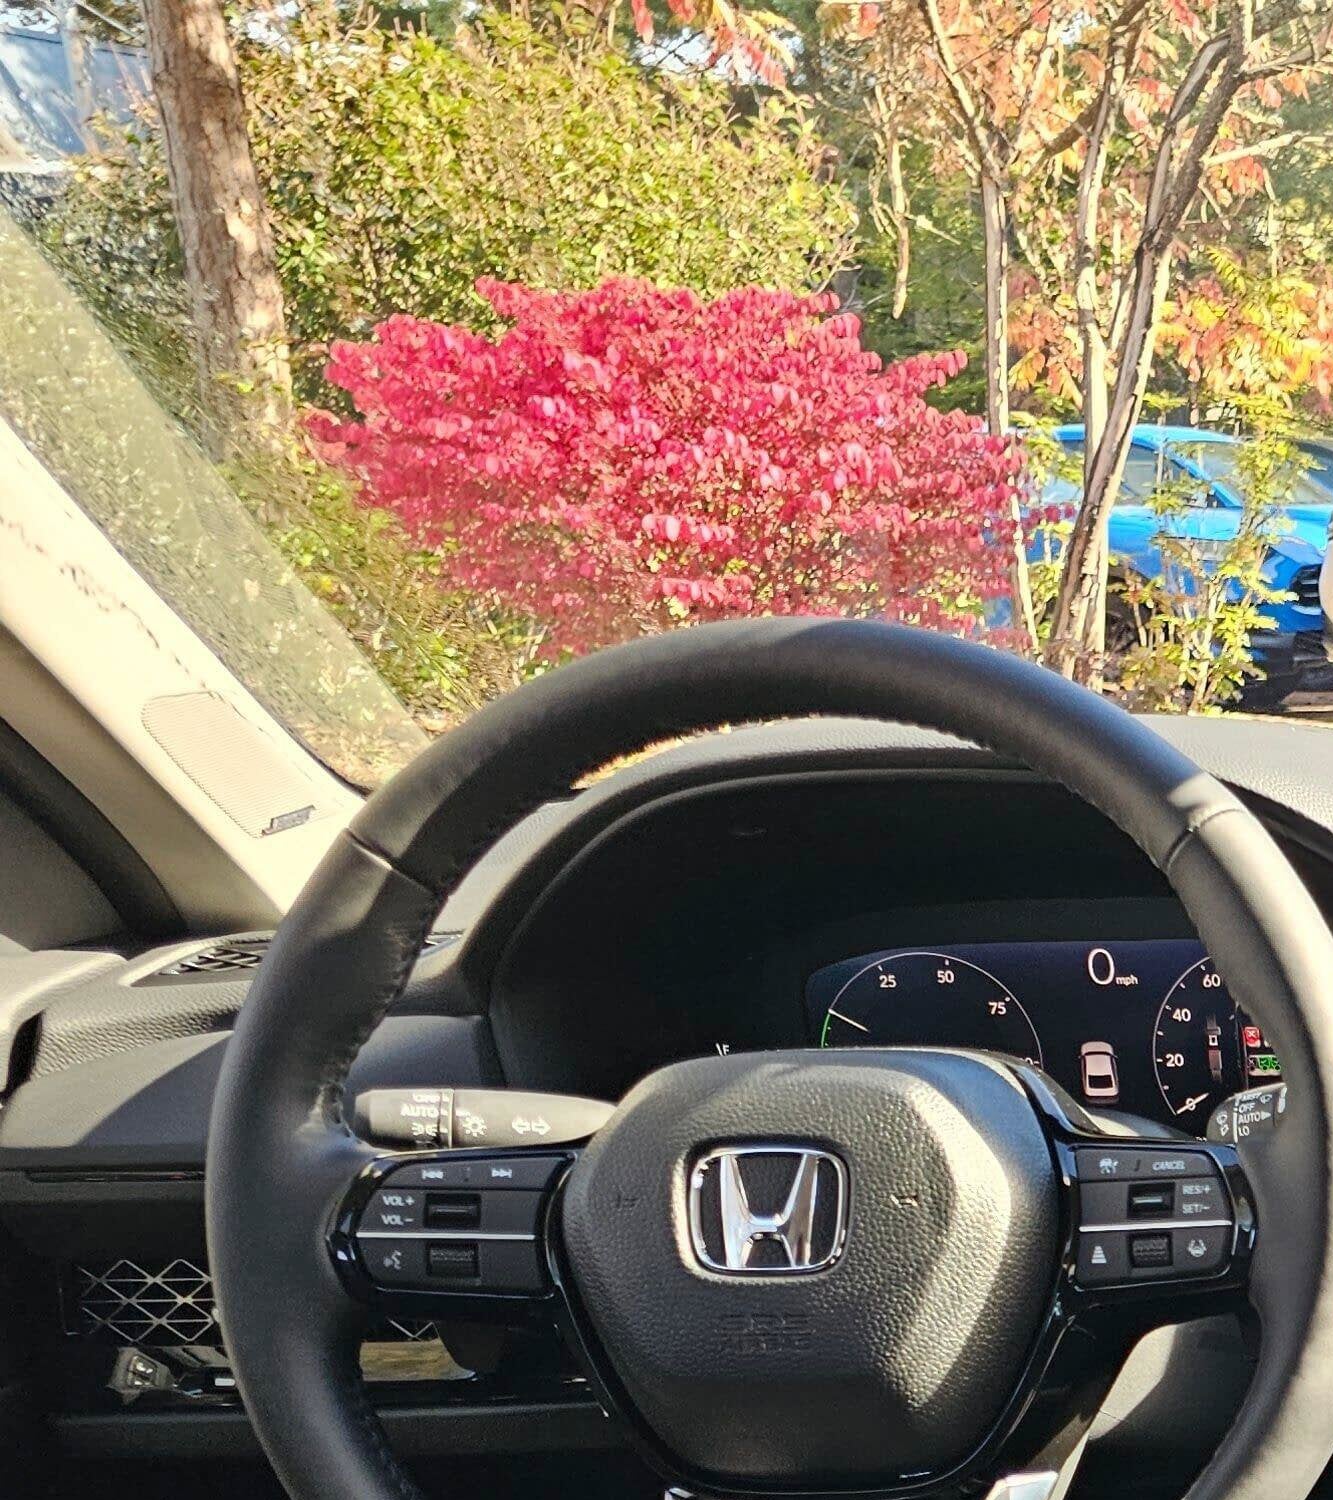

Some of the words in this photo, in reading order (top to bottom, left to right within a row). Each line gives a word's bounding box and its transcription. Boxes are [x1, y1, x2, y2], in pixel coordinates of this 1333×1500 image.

[1087, 948, 1115, 985] 0
[1115, 975, 1139, 988] mph
[879, 974, 896, 989] 25
[937, 971, 955, 984] 50
[1202, 974, 1221, 988] 60
[988, 1001, 1007, 1015] 75
[1172, 1008, 1191, 1023] 40
[1165, 1053, 1185, 1067] 20
[400, 1103, 440, 1118] AUTO
[1238, 1103, 1255, 1113] OFF
[1238, 1114, 1261, 1124] AUTO
[1238, 1126, 1250, 1136] LO
[1152, 1160, 1186, 1171] CANCEL
